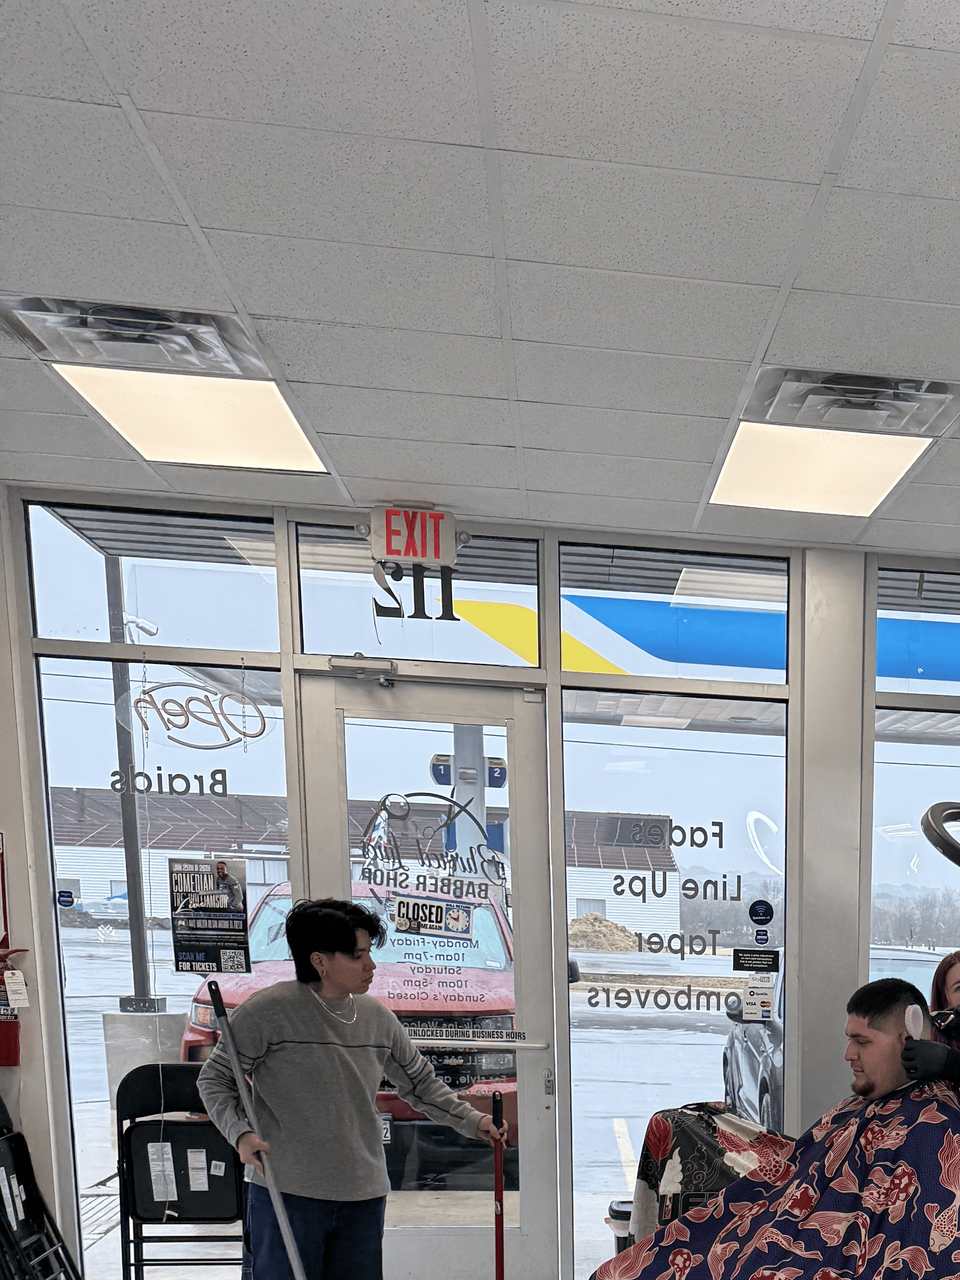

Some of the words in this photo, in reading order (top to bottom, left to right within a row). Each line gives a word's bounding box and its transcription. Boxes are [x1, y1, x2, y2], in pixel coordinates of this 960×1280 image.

[385, 509, 445, 559] EXIT
[438, 765, 445, 774] 1
[493, 768, 501, 777] 2
[172, 873, 214, 893] COMEDIAN
[397, 900, 444, 925] CLOSED
[179, 962, 191, 971] FOR
[192, 962, 217, 972] TICKETS
[408, 1029, 444, 1038] UNLOCKED
[445, 1030, 470, 1039] DURING
[472, 1030, 504, 1040] BUSINESS
